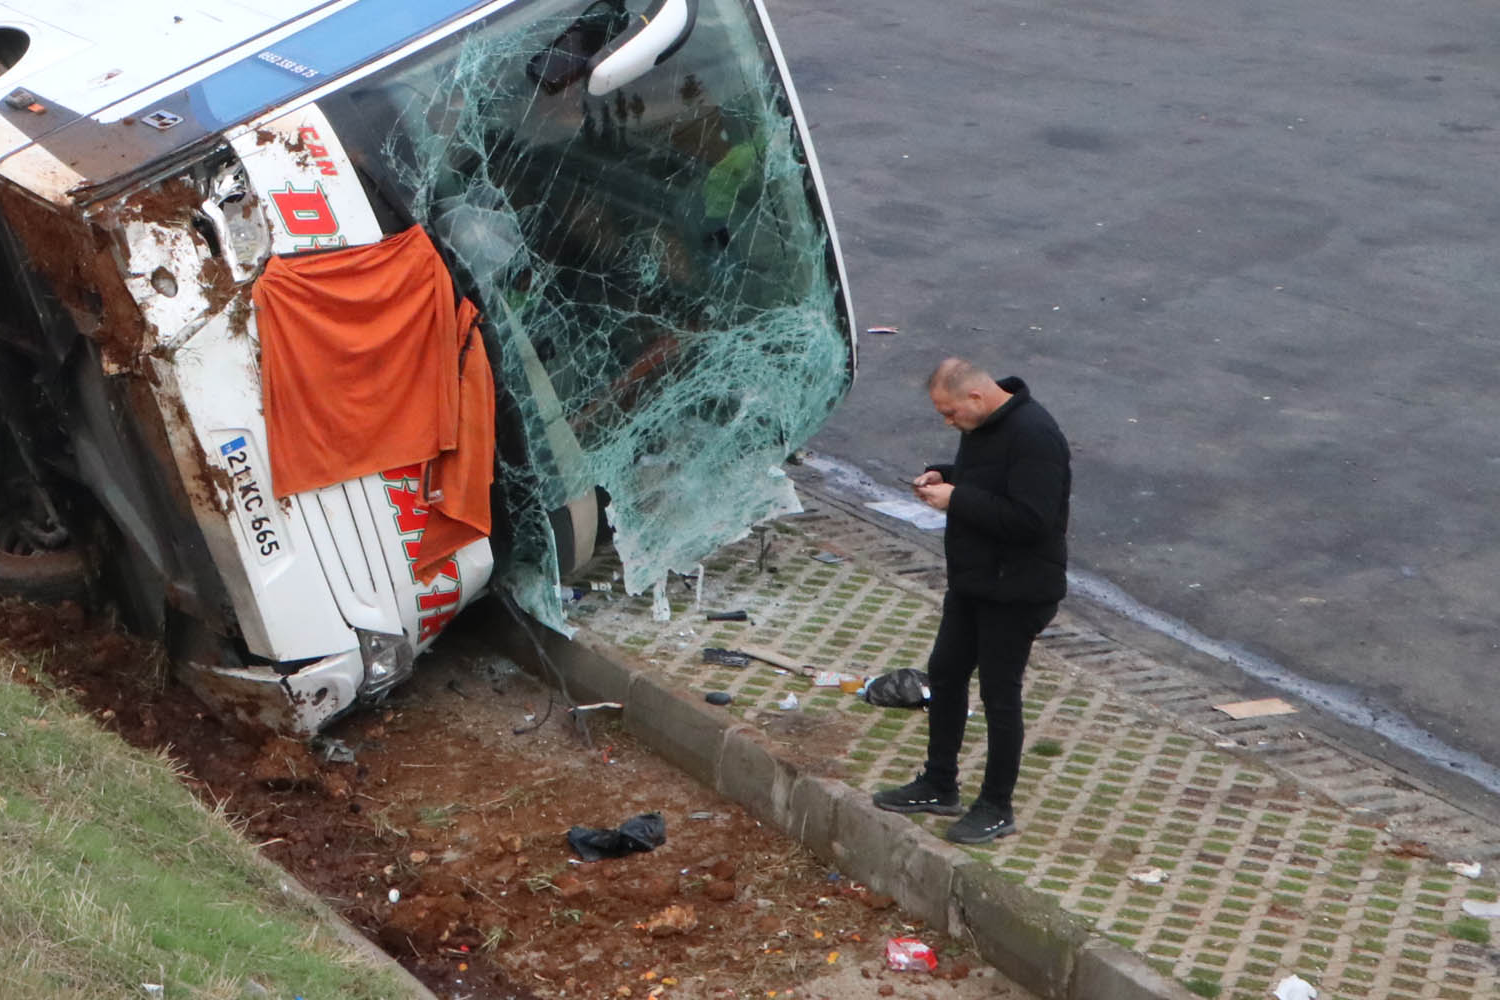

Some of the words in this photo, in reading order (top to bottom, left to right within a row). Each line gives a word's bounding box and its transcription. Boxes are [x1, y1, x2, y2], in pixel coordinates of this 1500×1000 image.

[297, 126, 339, 177] CAN
[227, 450, 252, 477] 21
[238, 480, 264, 512] KC
[250, 515, 280, 556] 665
